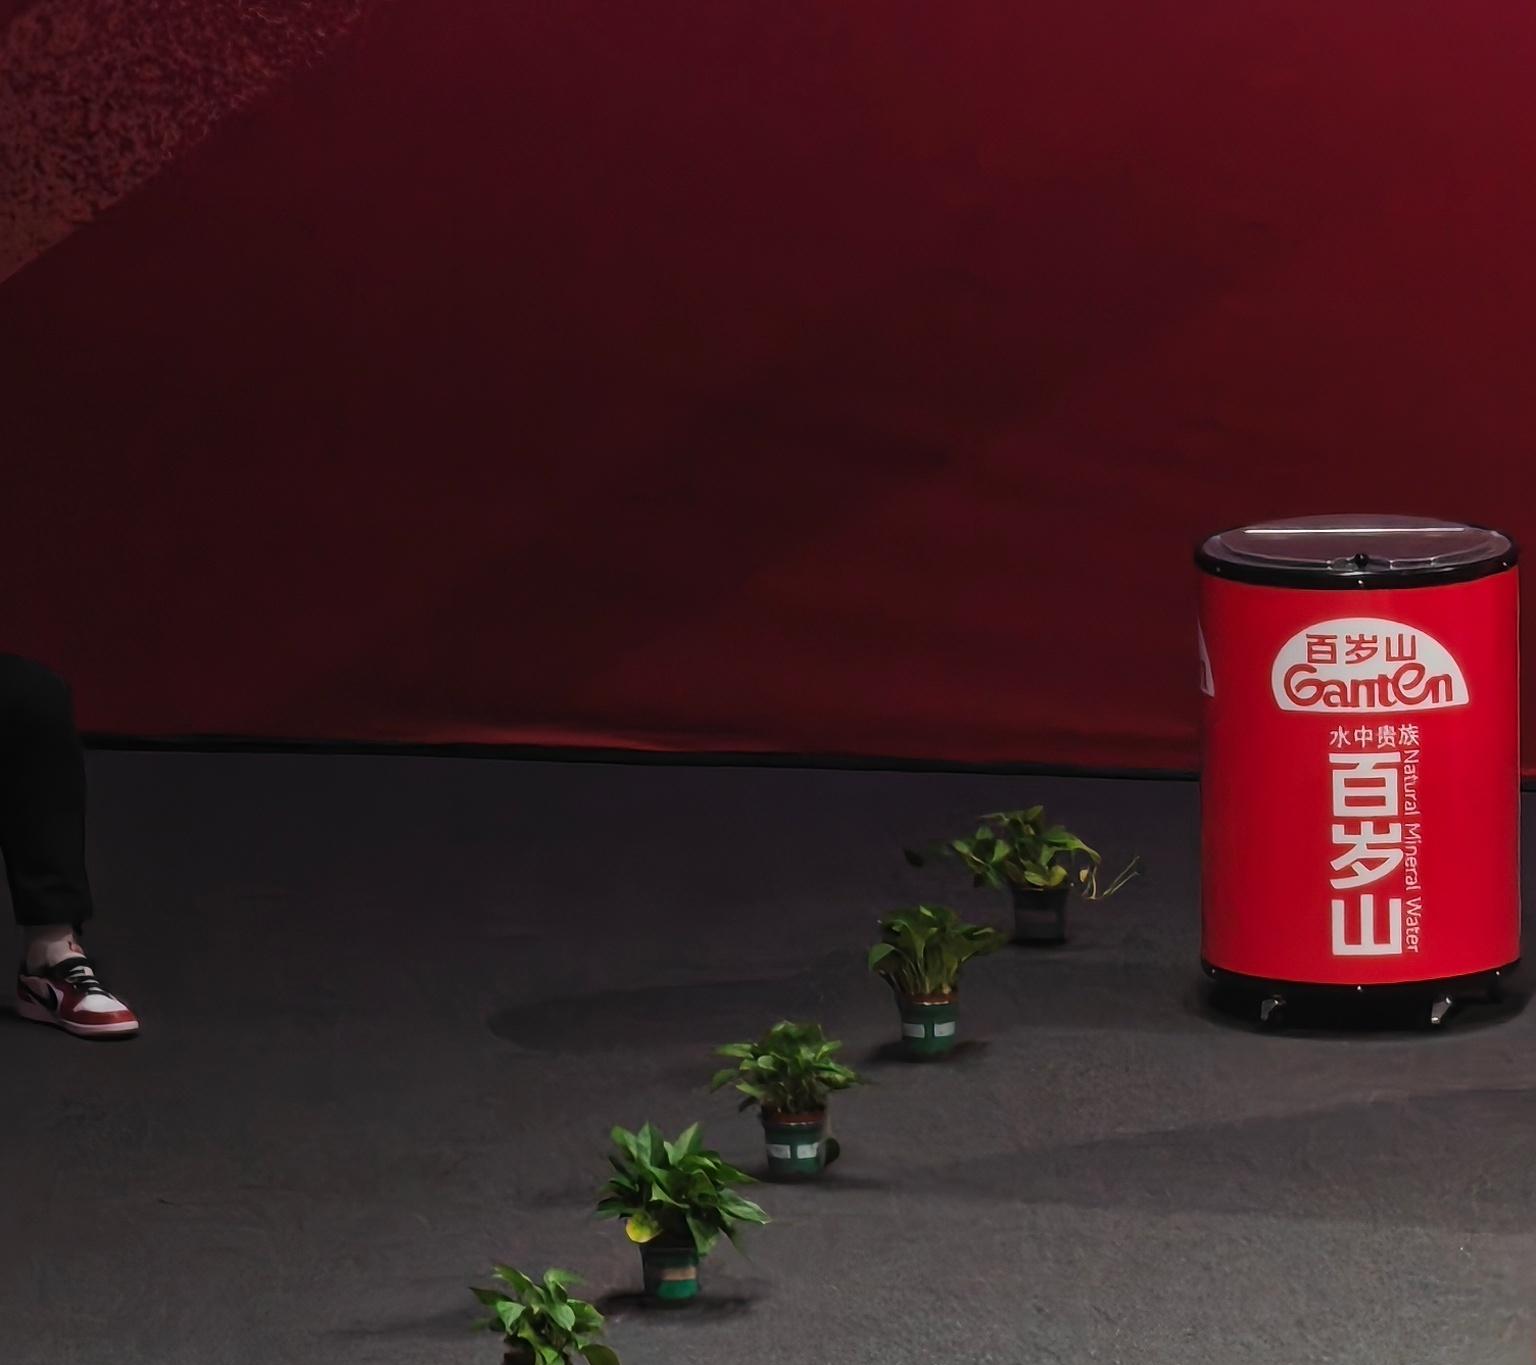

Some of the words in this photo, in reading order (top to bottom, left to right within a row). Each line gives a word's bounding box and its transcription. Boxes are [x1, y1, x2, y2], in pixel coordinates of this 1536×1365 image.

[1306, 632, 1418, 665] 百岁山
[1283, 662, 1454, 709] Ganten
[1329, 724, 1419, 749] 水中贵族
[1402, 749, 1419, 816] Natural
[1328, 752, 1404, 957] 百岁山
[1402, 823, 1421, 892] Mineral
[1403, 897, 1422, 953] Water
